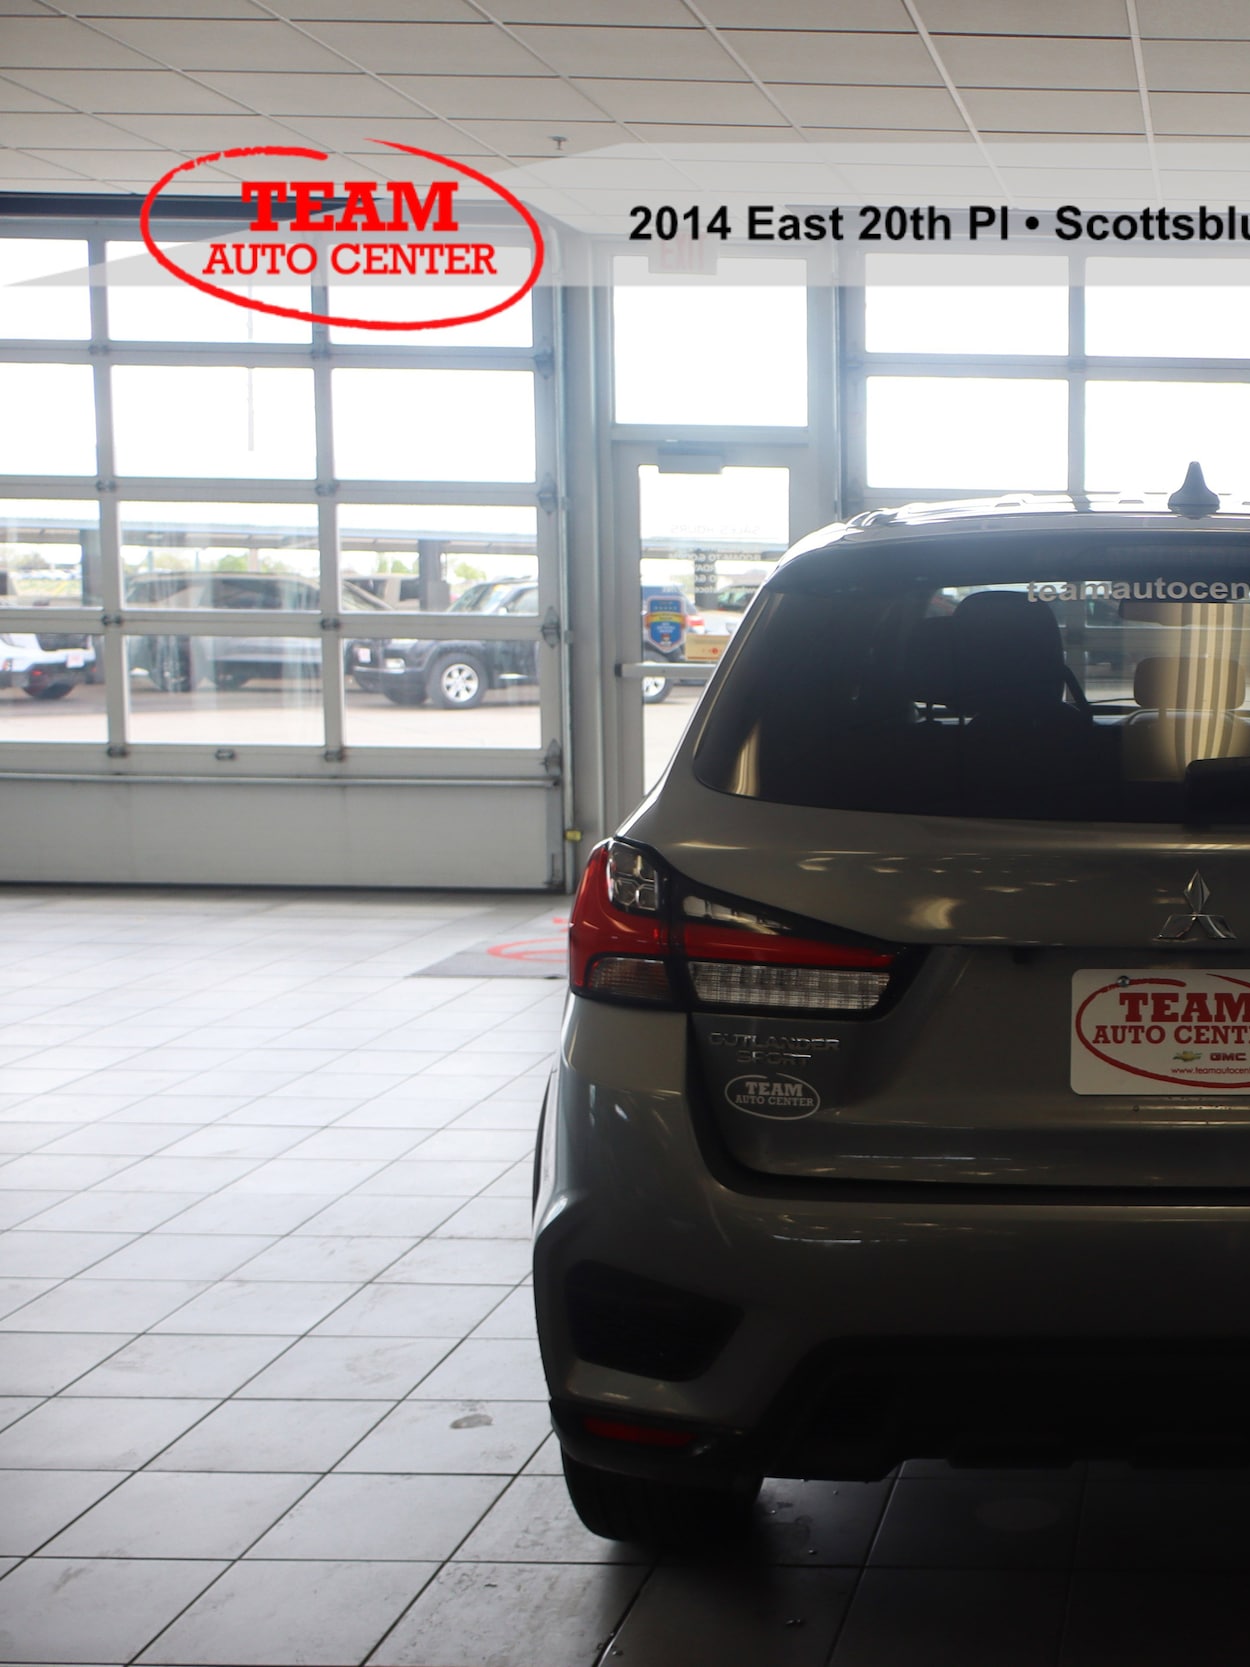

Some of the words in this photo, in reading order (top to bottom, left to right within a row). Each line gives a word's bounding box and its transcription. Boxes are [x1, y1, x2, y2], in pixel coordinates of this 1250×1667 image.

[709, 1032, 840, 1050] OUTLANDER
[1092, 1024, 1166, 1044] AUTO
[737, 1050, 812, 1065] SPORT
[1209, 1052, 1247, 1062] GMC
[745, 1081, 804, 1097] TEAM
[735, 1094, 765, 1105] AUTO
[767, 1096, 815, 1107] CENTER
